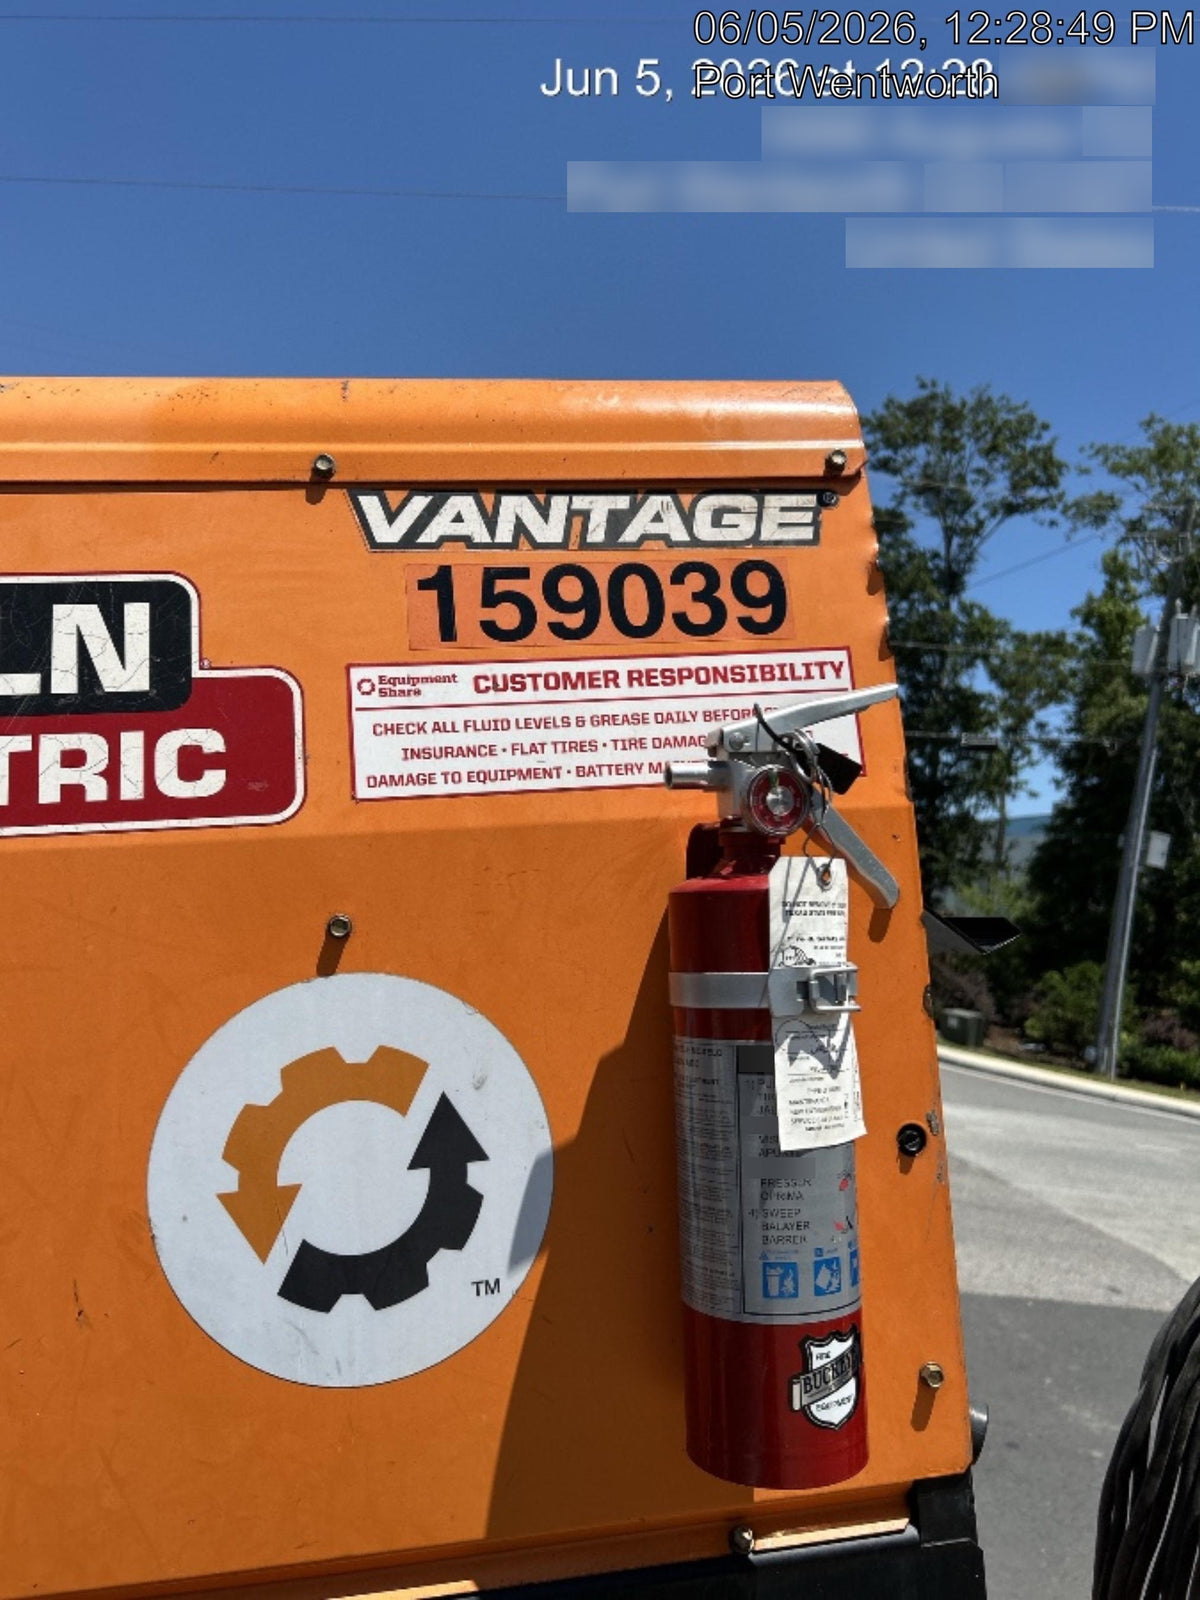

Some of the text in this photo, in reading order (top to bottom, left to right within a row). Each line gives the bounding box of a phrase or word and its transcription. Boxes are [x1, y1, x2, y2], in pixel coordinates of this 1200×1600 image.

[355, 492, 819, 545] VANTAGE
[416, 559, 788, 643] 159039
[377, 673, 459, 687] Equipment
[472, 660, 845, 695] CUSTOMER RESPONSIBILITY
[377, 687, 423, 698] Share
[372, 720, 428, 737] CHECK
[431, 719, 460, 735] ALL
[463, 717, 512, 734] FLUID
[514, 715, 572, 731] LEVELS
[575, 715, 586, 728] &
[590, 712, 651, 727] GREASE
[654, 709, 699, 725] DAILY
[400, 734, 706, 762] INSURANCE FLAT TIRES TIRE DAMAG
[366, 772, 437, 789] DAMAGE
[441, 770, 463, 785] TO
[466, 765, 563, 785] EQUIPMENT
[575, 761, 651, 779] BATTERY
[470, 1277, 501, 1297] TM
